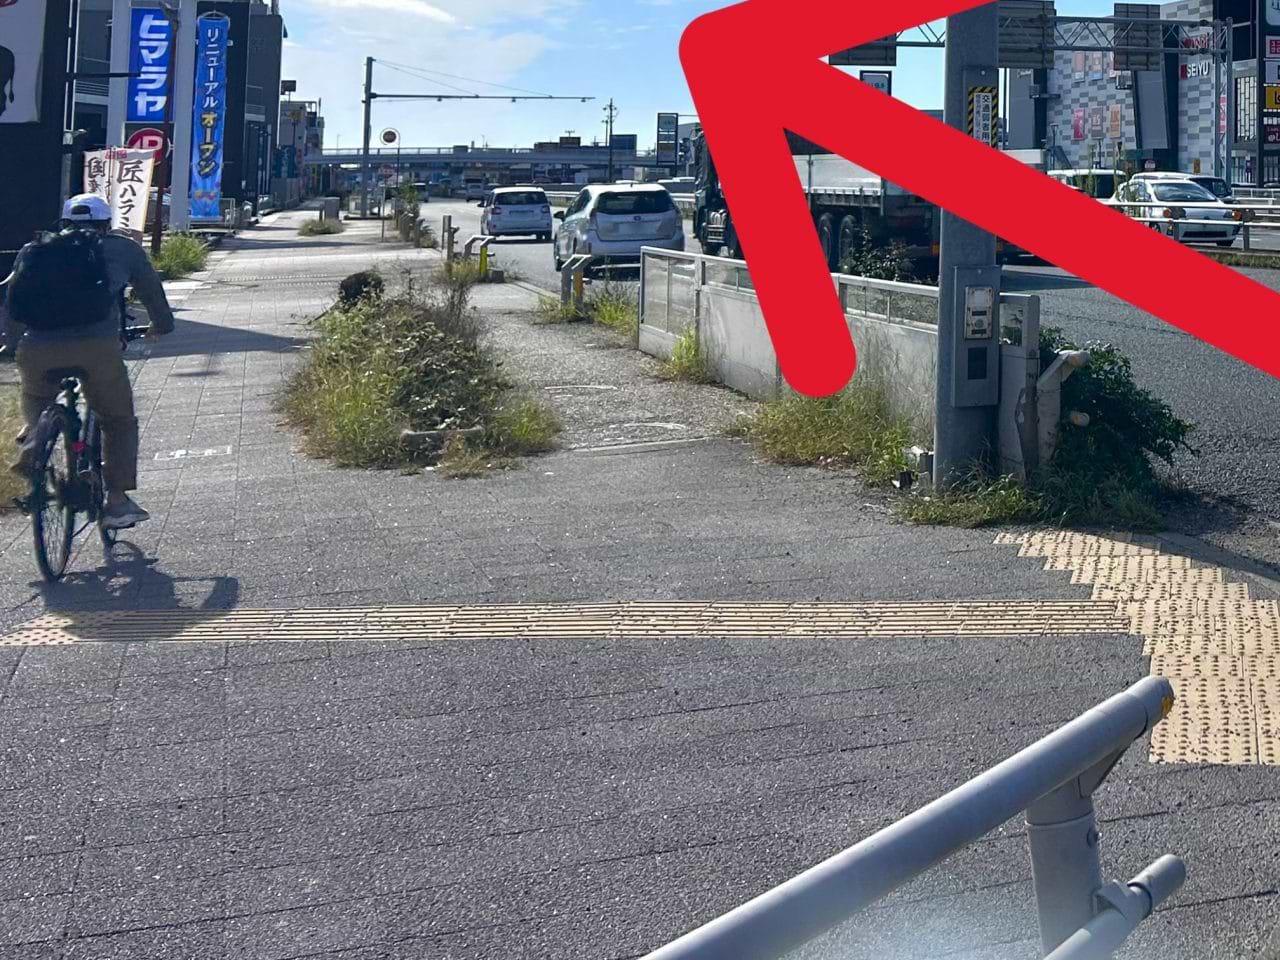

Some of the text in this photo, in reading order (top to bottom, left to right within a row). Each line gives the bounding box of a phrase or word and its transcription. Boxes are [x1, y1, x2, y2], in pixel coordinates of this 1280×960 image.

[134, 14, 169, 117] ヒマラヤ
[1187, 62, 1210, 76] SEIYU
